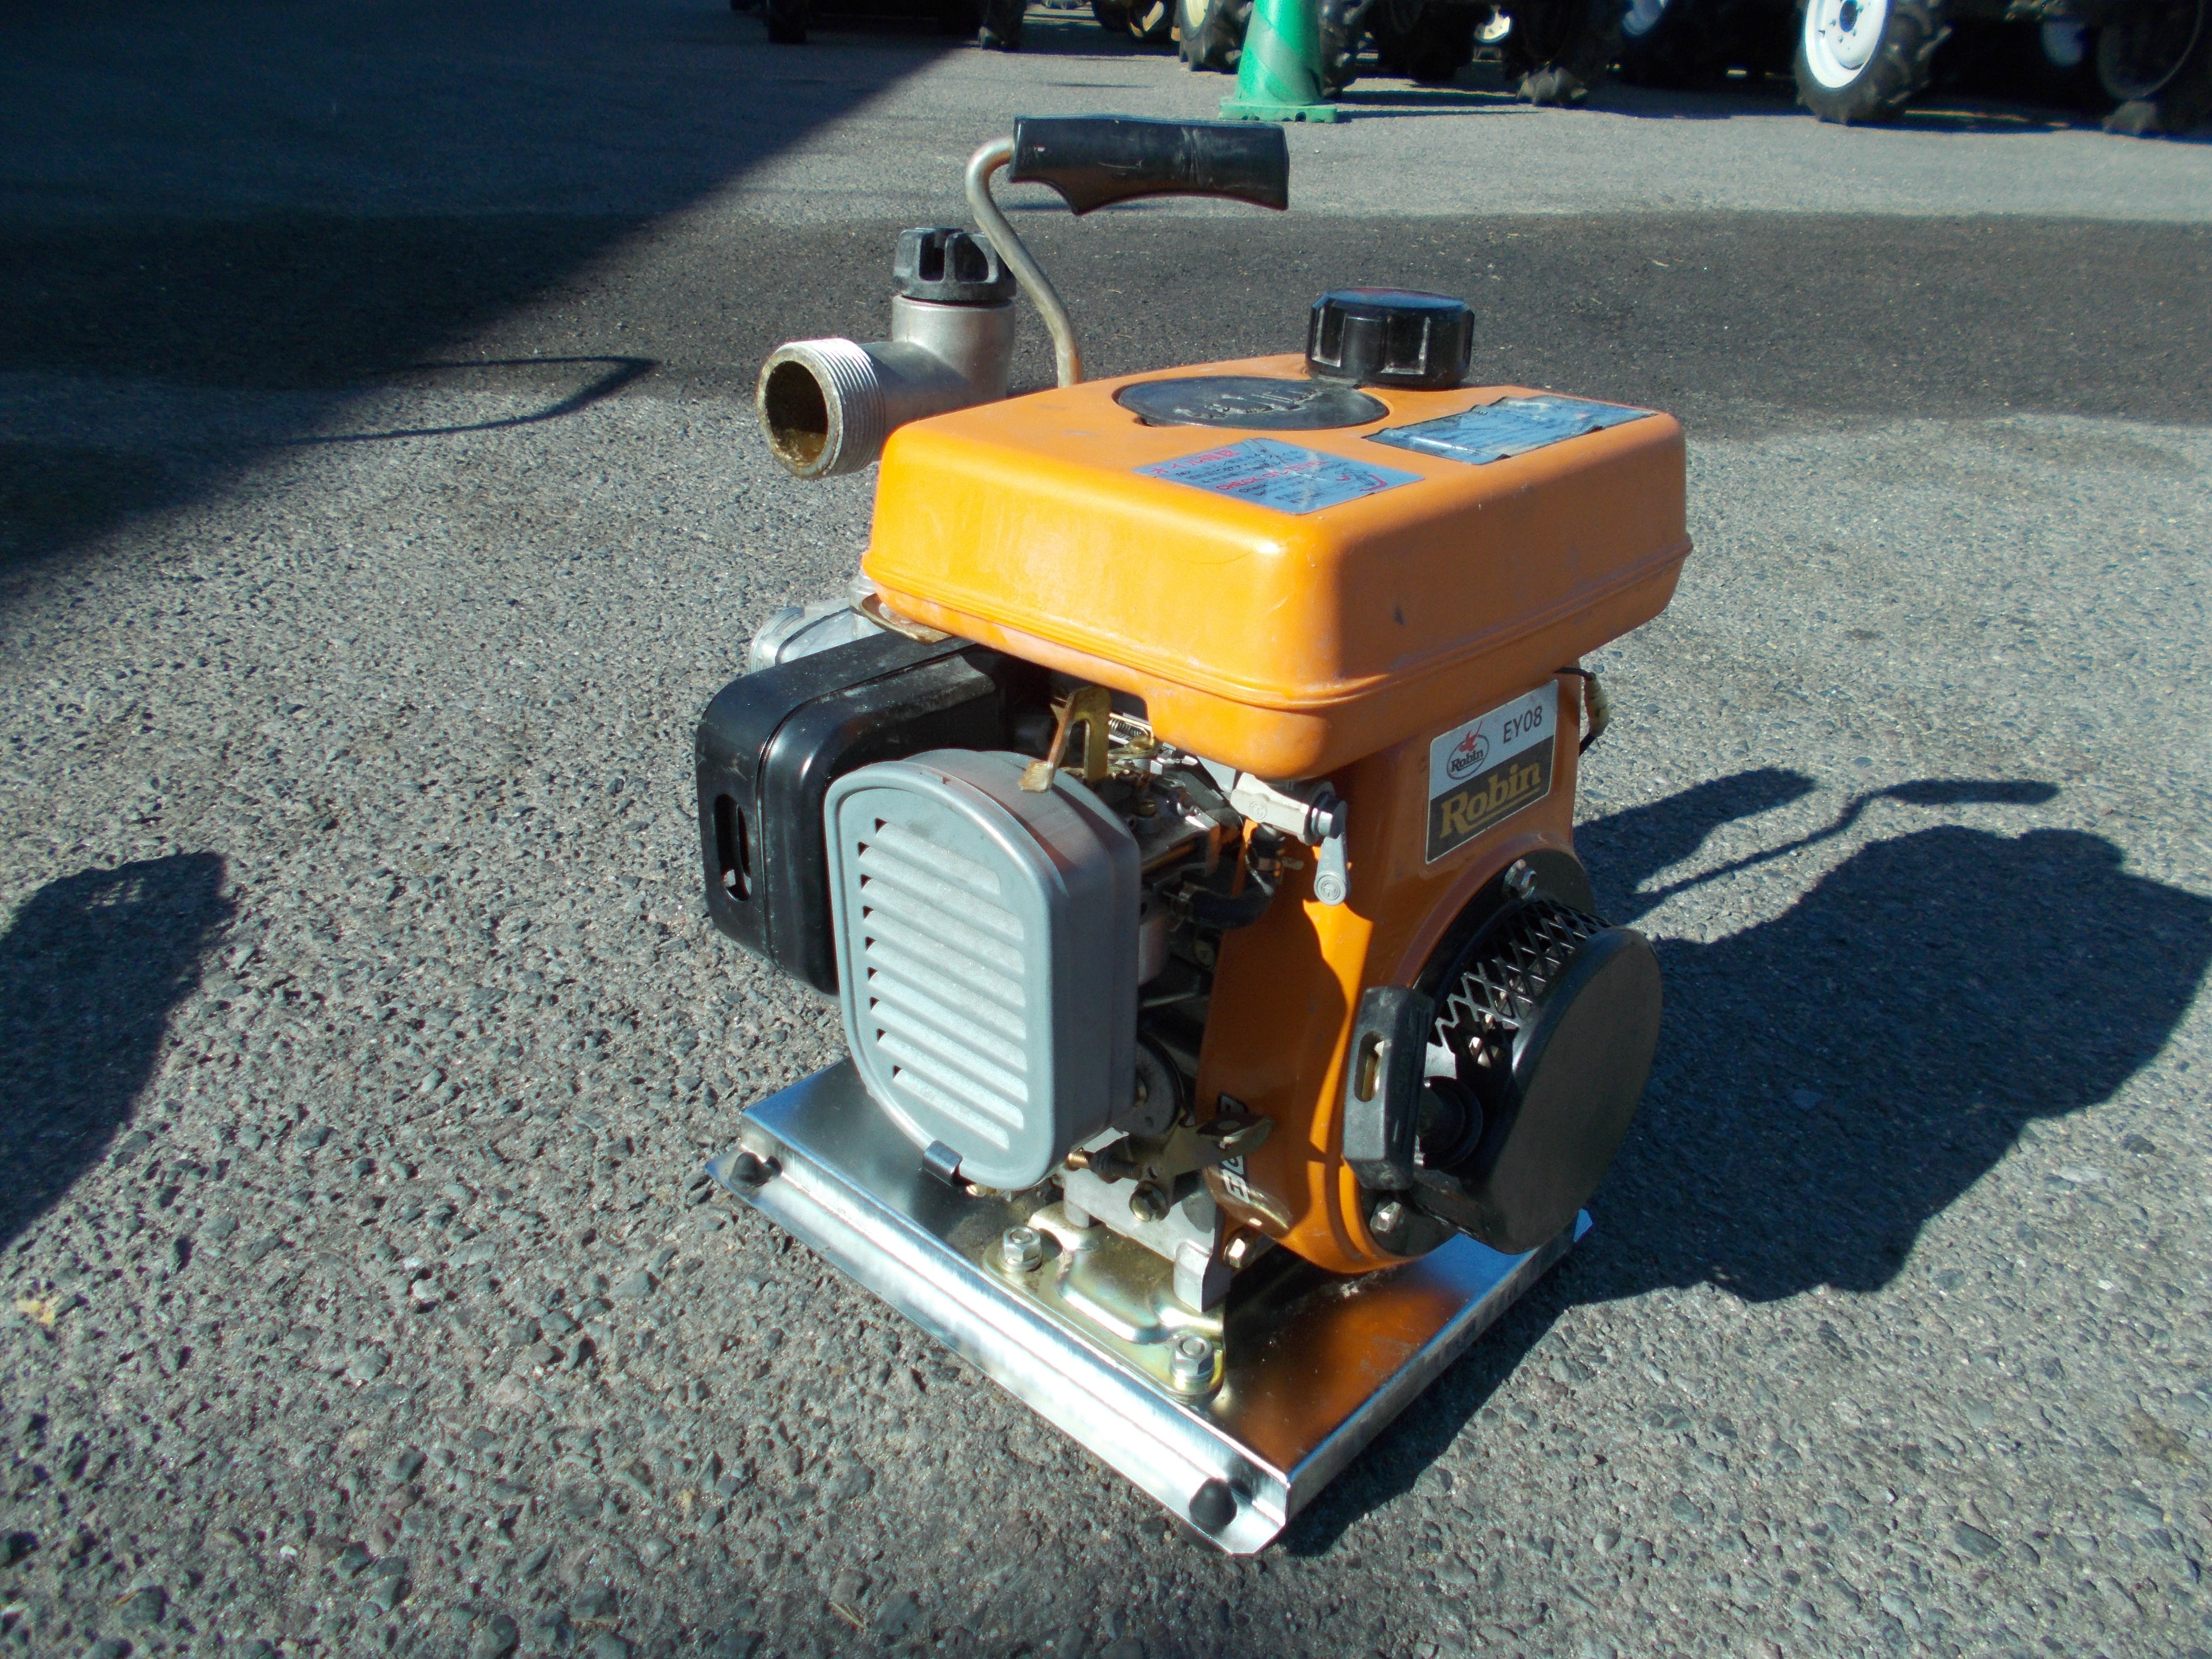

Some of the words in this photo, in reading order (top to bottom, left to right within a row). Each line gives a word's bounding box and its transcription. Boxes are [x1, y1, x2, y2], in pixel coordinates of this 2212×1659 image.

[1503, 706, 1542, 744] EY08
[1451, 748, 1484, 772] Robin
[1439, 763, 1541, 839] Robin
